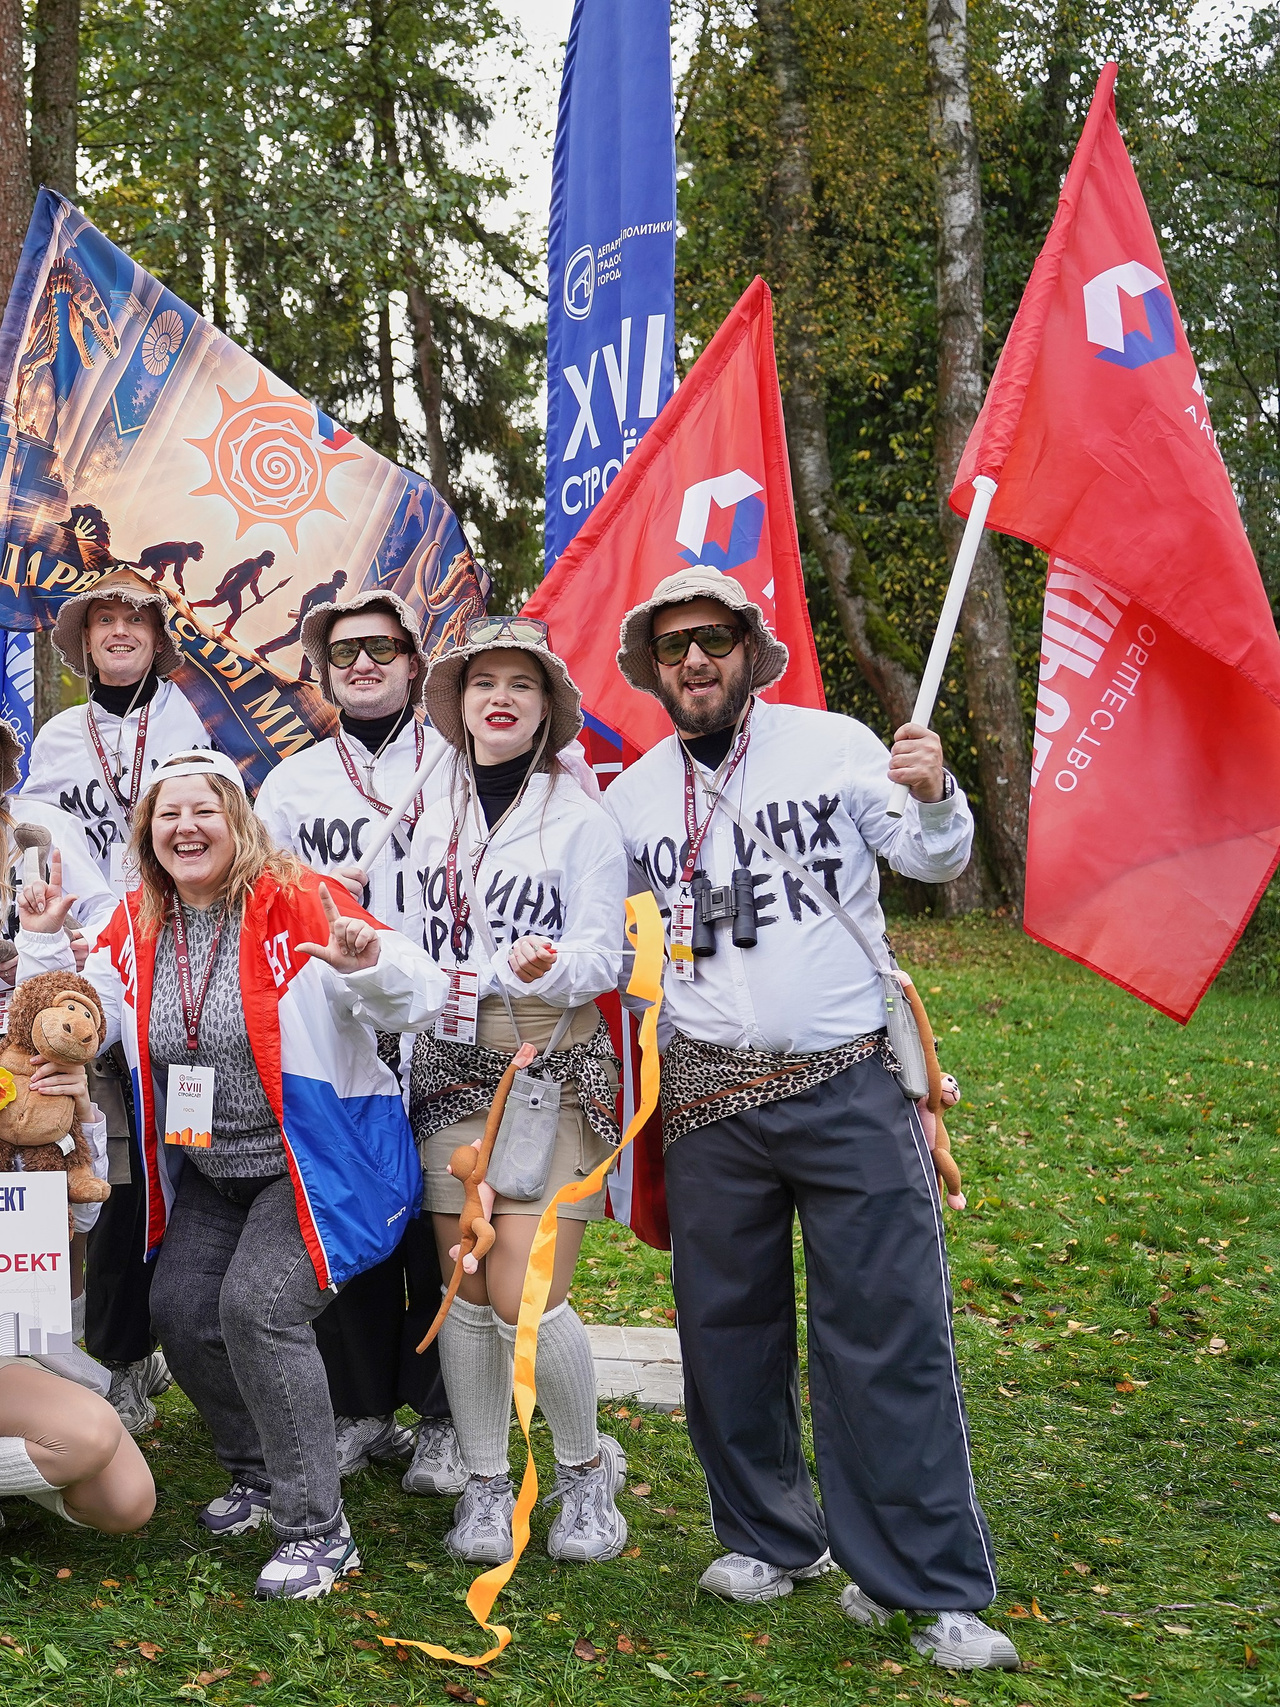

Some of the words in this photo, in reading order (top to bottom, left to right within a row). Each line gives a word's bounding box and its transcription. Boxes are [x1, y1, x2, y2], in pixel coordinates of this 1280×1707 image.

[622, 220, 673, 240] ПОЛИТИКИ
[597, 268, 622, 287] ГОРОД
[242, 686, 318, 759] МИ
[134, 746, 144, 769] ГОРОДА
[129, 770, 141, 803] ФУНДАМЕНТ
[685, 803, 698, 840] ФУНДАМЕНТ
[174, 918, 185, 944] ГОРОДА
[181, 972, 193, 1007] ФУНДАМЕНТ
[178, 1081, 202, 1093] XVIII
